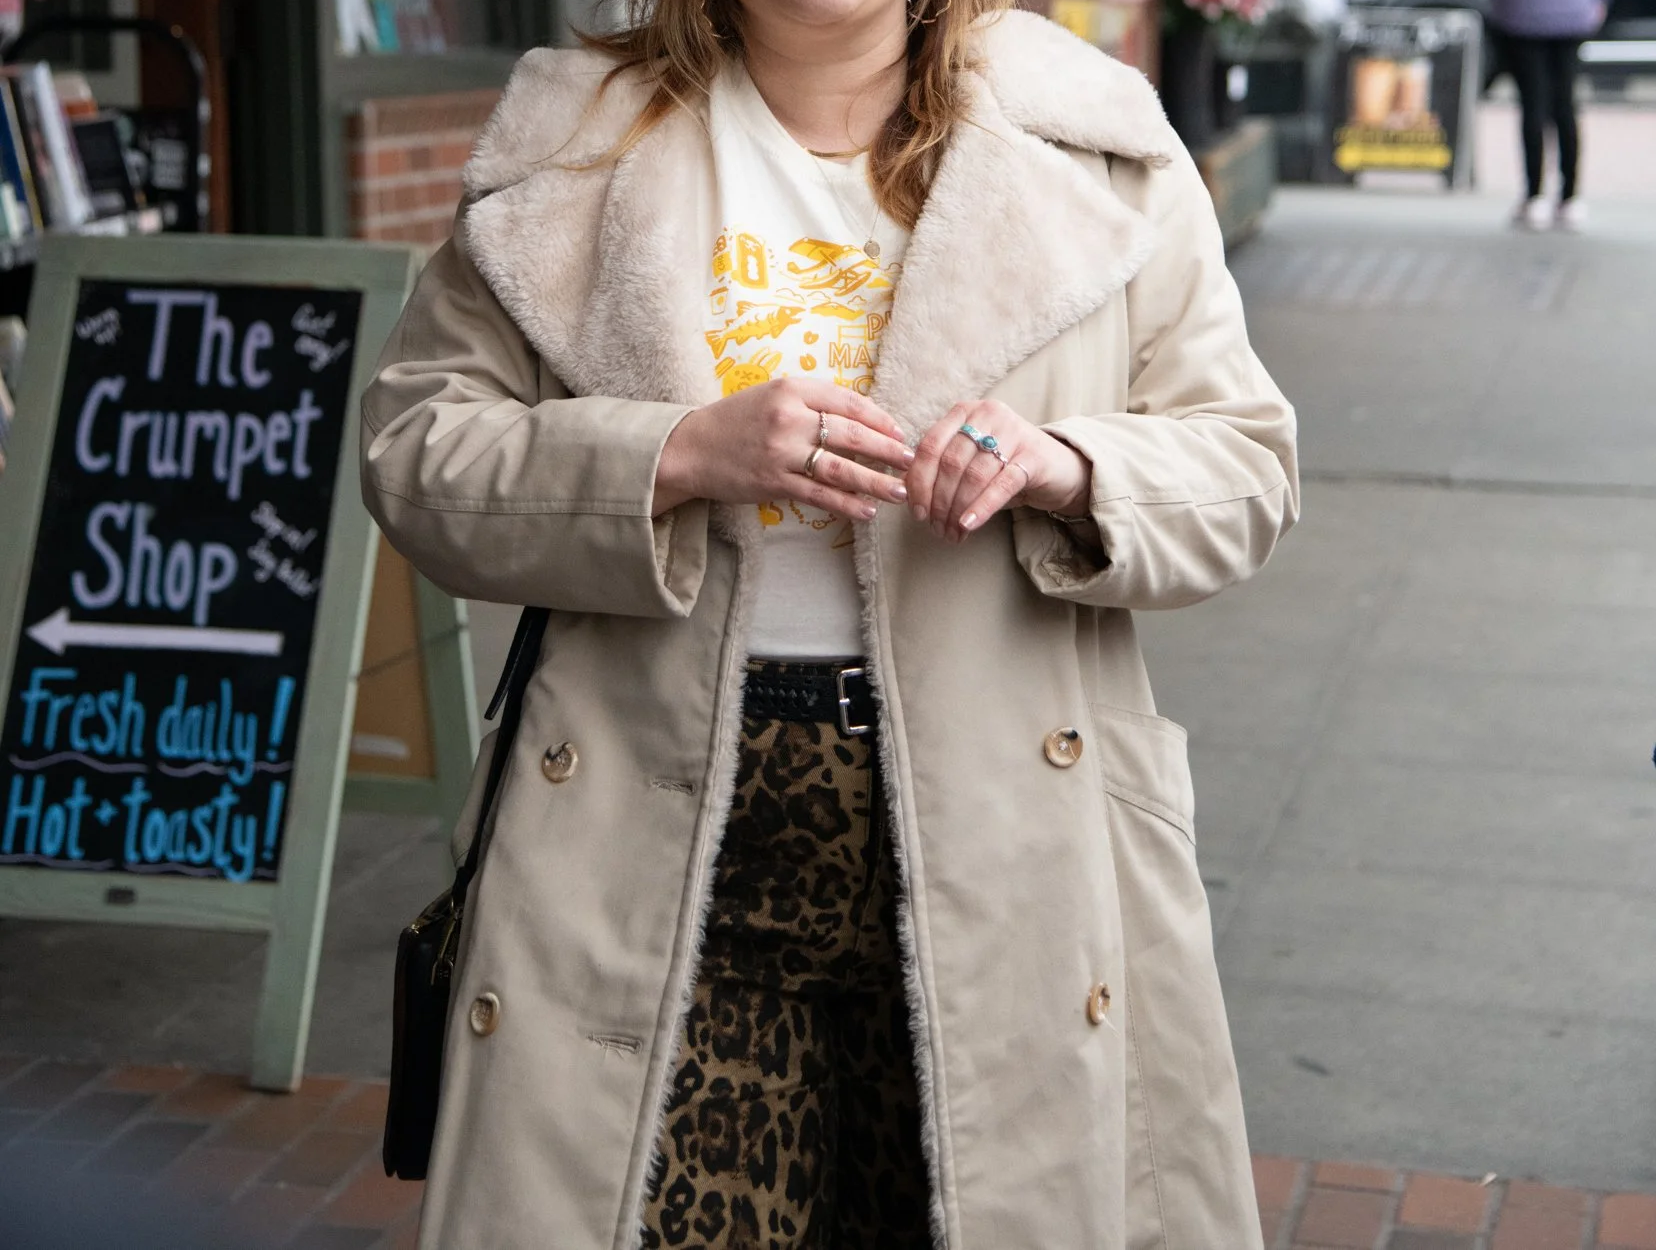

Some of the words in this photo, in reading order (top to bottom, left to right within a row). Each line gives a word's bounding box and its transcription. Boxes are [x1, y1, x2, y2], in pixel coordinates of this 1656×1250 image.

[126, 288, 274, 388] The
[75, 375, 323, 501] Crumpet
[71, 501, 239, 626] Shop
[21, 667, 146, 758] Fresh
[1, 774, 93, 861] Hot
